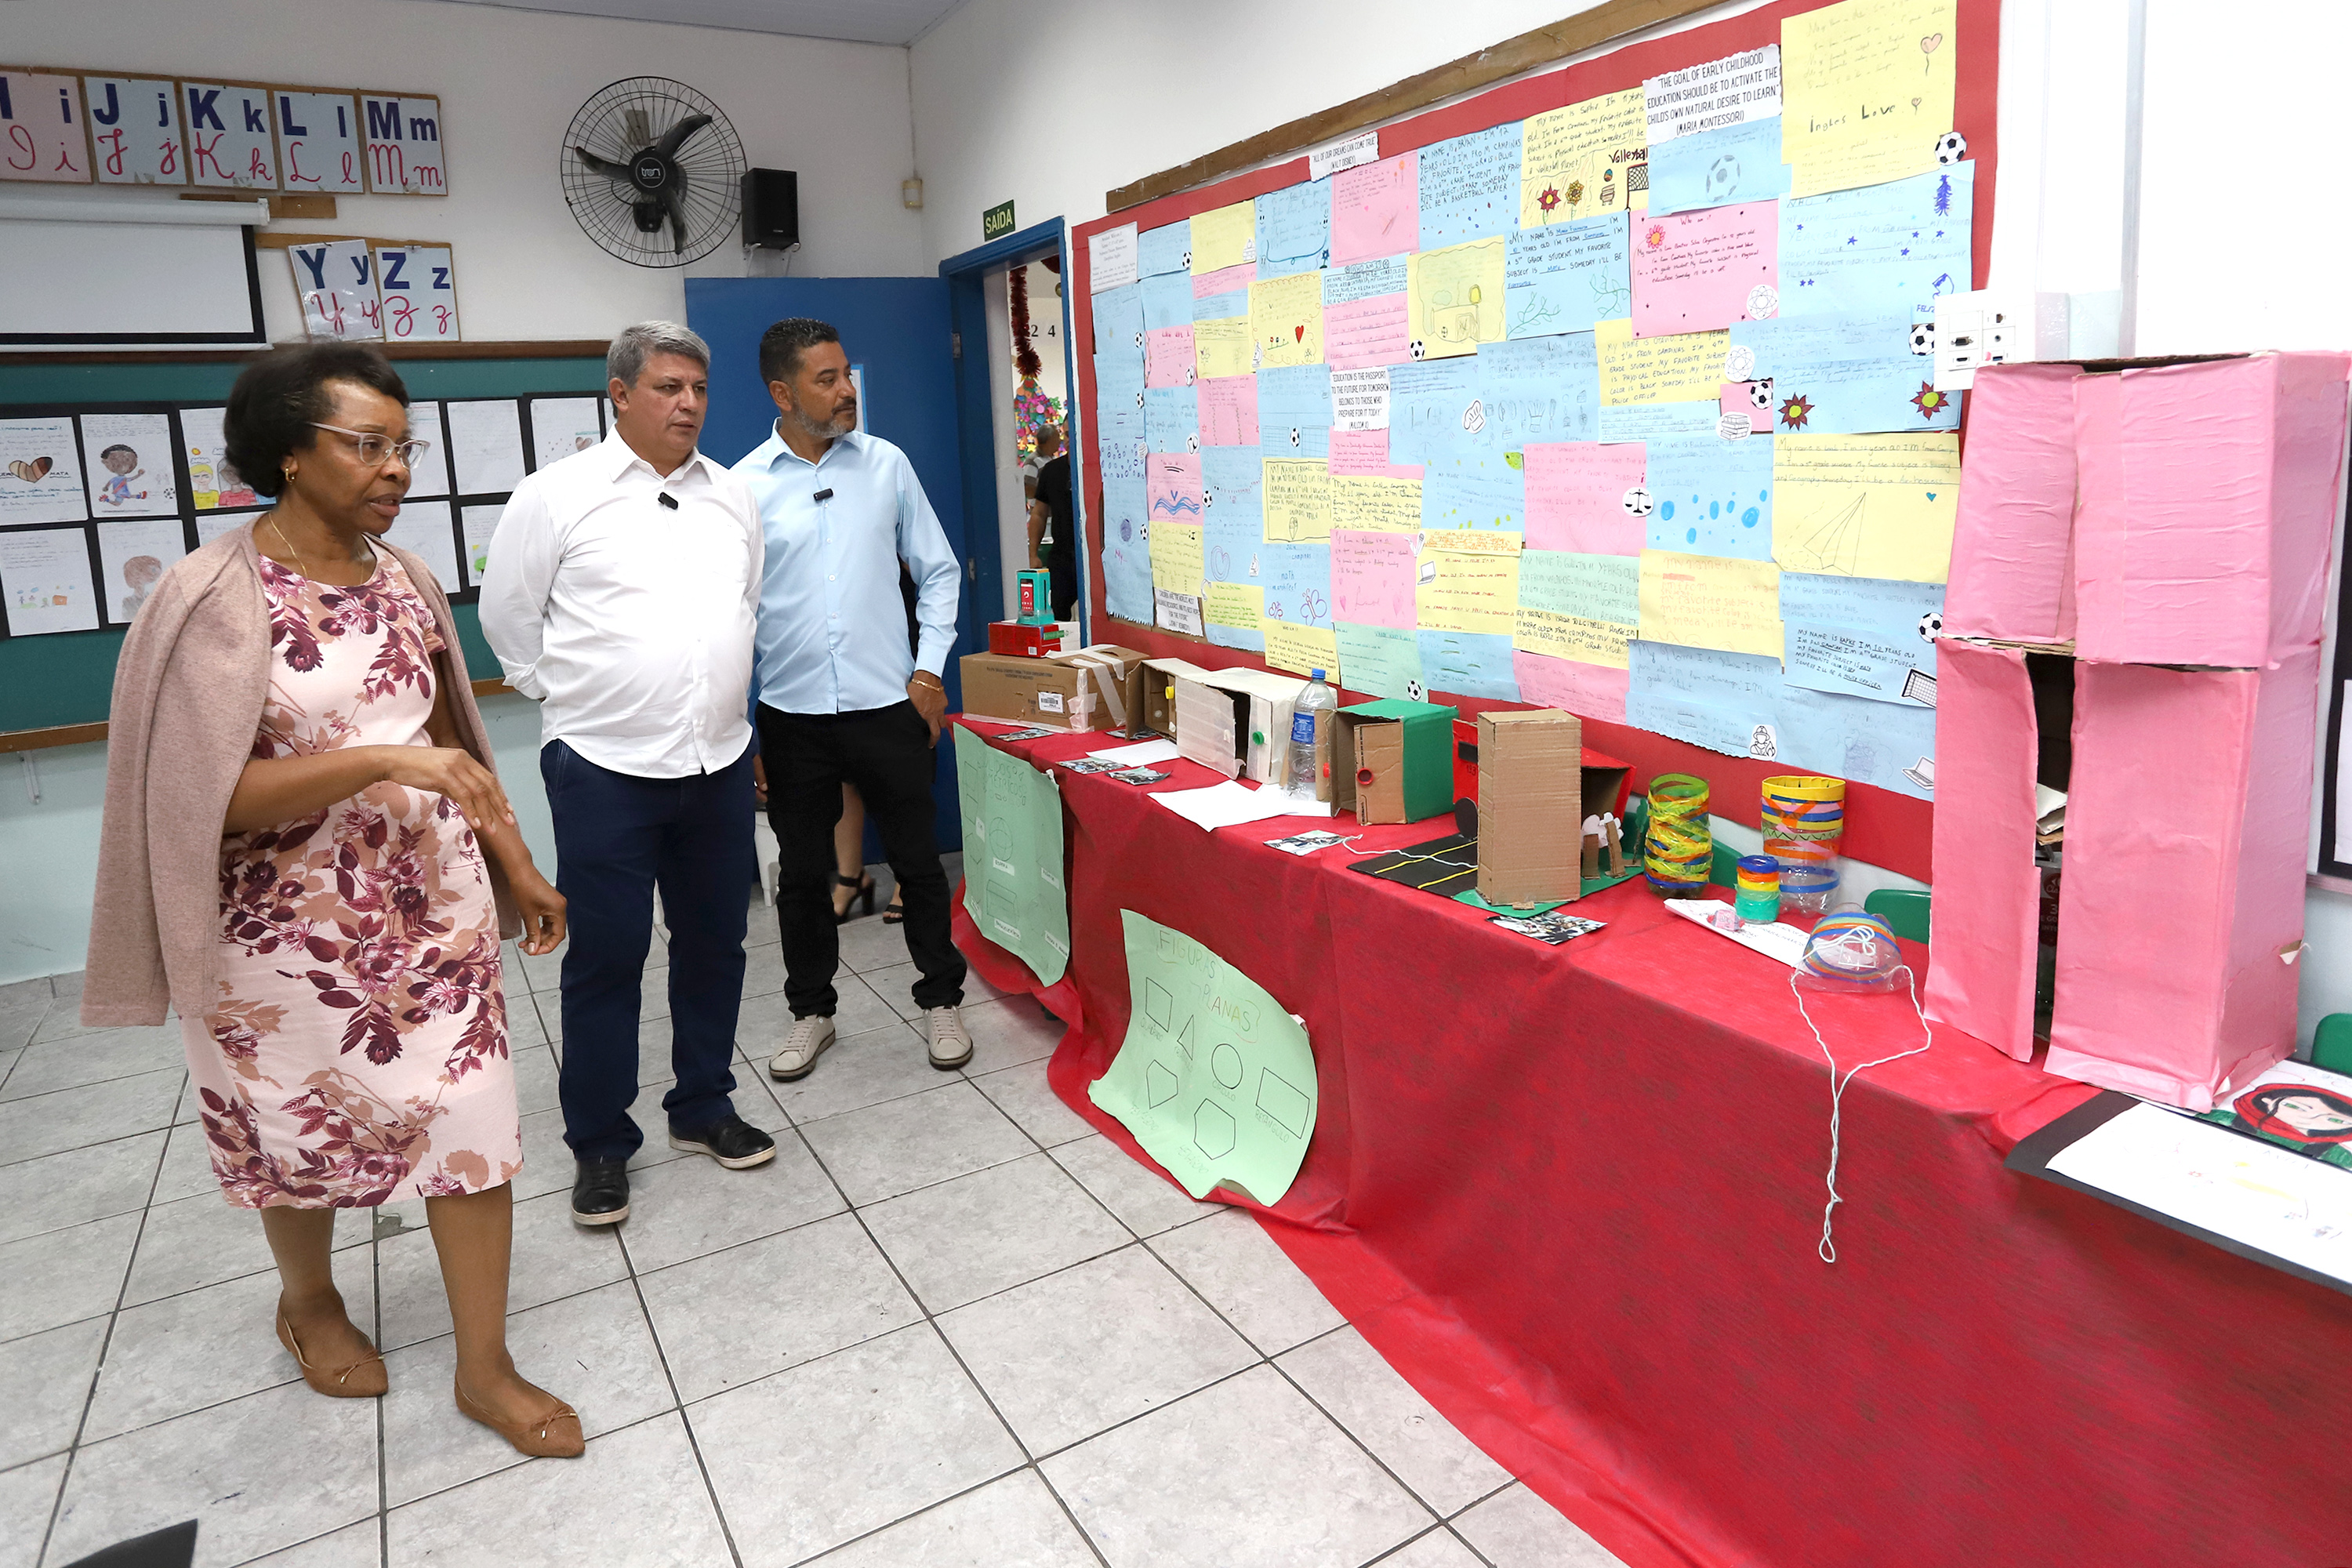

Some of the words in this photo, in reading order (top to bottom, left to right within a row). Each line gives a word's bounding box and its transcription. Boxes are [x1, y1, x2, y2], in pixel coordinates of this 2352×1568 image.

[1648, 92, 1682, 109] EDUCATION
[1683, 85, 1708, 100] SHOULD
[1710, 82, 1718, 93] BE
[1720, 80, 1729, 91] TO
[1731, 71, 1762, 88] ACTIVATE
[1765, 67, 1778, 79] THE
[1673, 72, 1690, 85] GOAL
[1691, 69, 1700, 81] OF
[1702, 63, 1724, 78] EARLY
[1726, 53, 1764, 72] CHILDHOOD
[60, 89, 71, 123] i
[93, 82, 120, 125] J
[158, 93, 169, 127] j
[188, 88, 226, 131] K
[242, 99, 266, 132] k
[280, 96, 307, 136] L
[368, 101, 402, 140] M
[410, 117, 437, 141] m
[1647, 110, 1669, 125] CHILD'S
[1670, 107, 1683, 118] OWN
[1685, 99, 1715, 115] NATURAL
[1717, 94, 1740, 109] DESIRE
[1743, 92, 1751, 103] TO
[195, 132, 234, 179] K
[249, 147, 272, 180] k
[368, 144, 408, 185] M
[413, 165, 441, 187] m
[985, 208, 1013, 234] SAÍDA
[296, 248, 326, 289] Y
[350, 256, 368, 285] y
[382, 252, 410, 289] Z
[432, 267, 451, 289] z
[1031, 324, 1038, 337] 2
[1047, 325, 1056, 337] 4
[1159, 930, 1216, 978] FIGURAS
[1202, 984, 1252, 1032] PLANAS
